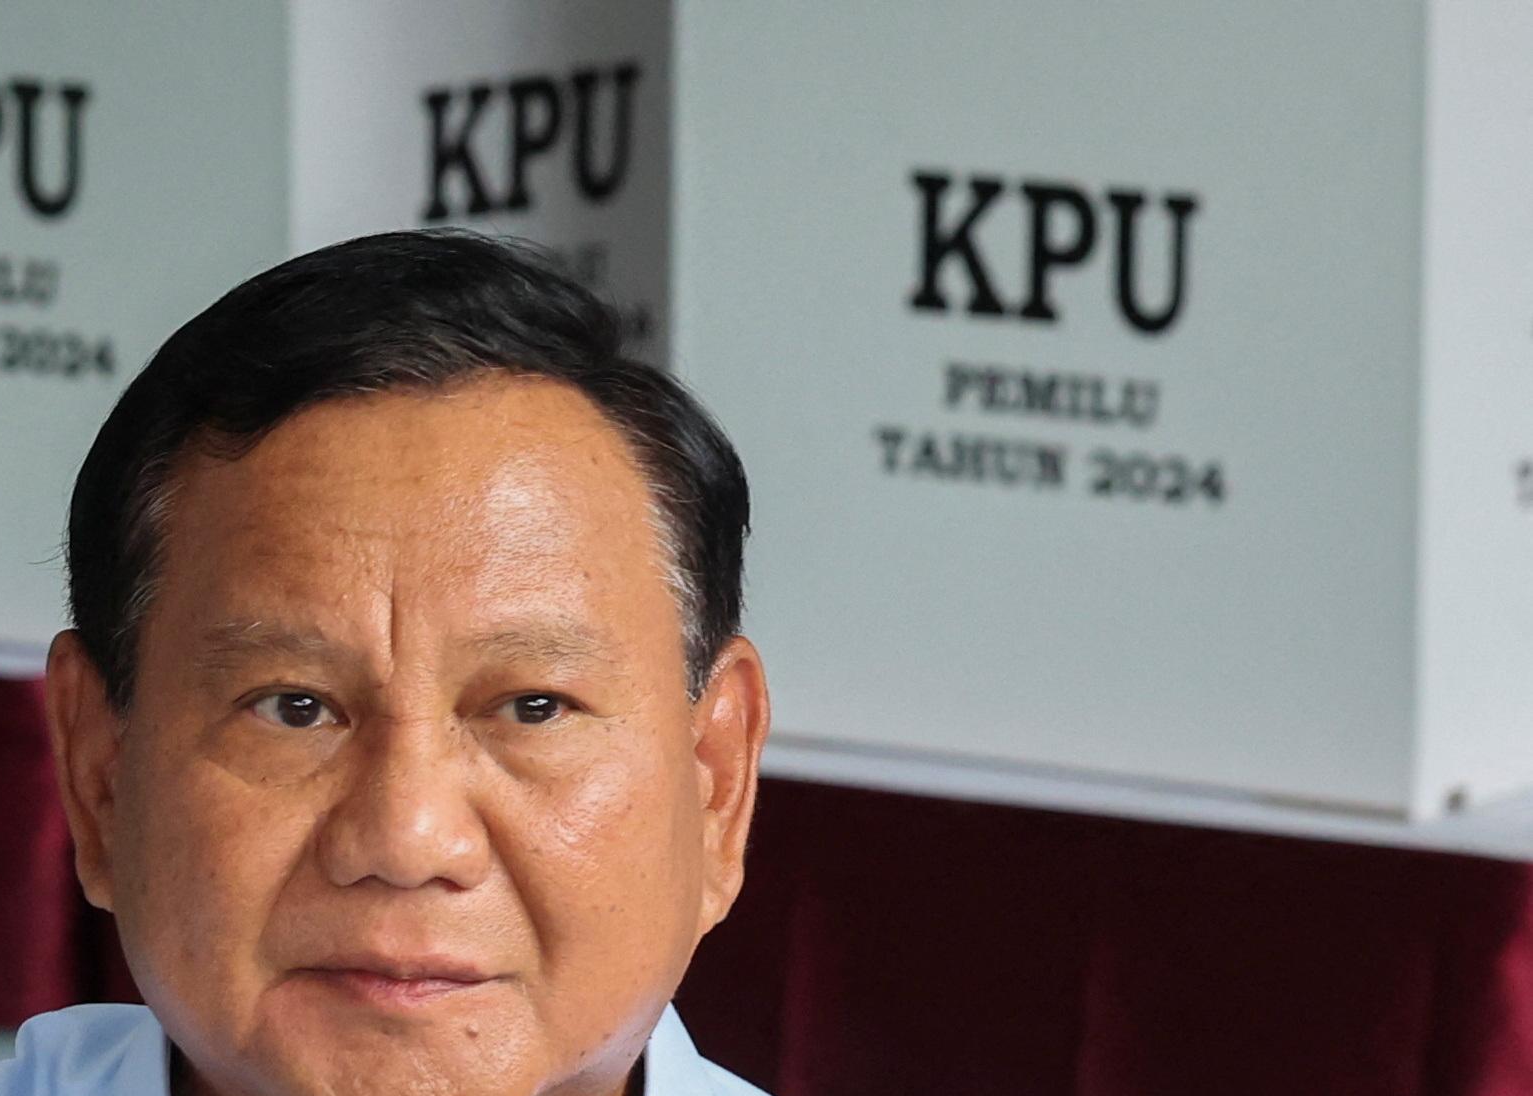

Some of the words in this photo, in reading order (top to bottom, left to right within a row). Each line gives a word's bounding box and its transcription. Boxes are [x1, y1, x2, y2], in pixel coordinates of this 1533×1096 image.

[423, 60, 641, 221] KPU
[908, 171, 1200, 336] KPU
[944, 362, 1160, 425] PEMILU
[874, 425, 1064, 486] TAHUN
[1087, 448, 1226, 503] 2024
